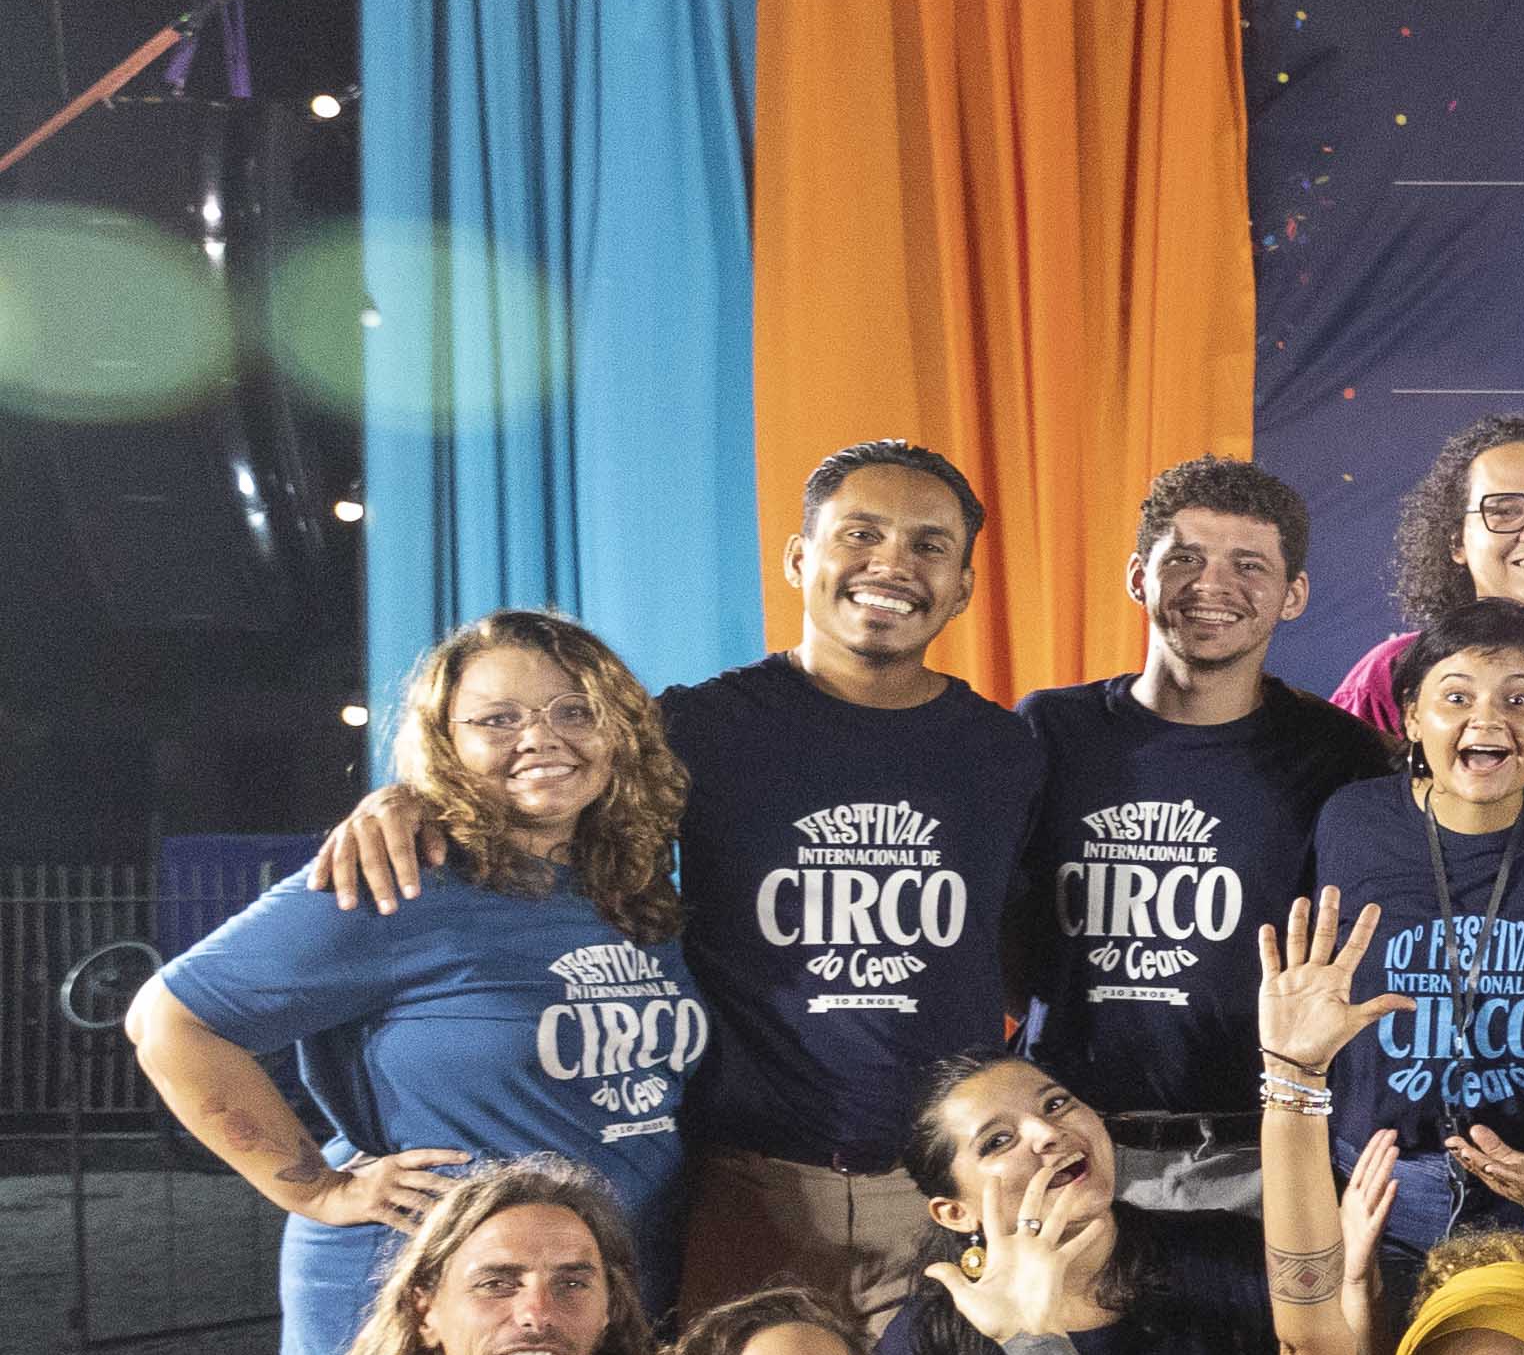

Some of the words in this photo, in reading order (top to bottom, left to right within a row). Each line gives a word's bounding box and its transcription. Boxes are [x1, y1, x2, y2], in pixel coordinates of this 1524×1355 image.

[793, 800, 941, 845] FESTIVAL
[1082, 799, 1221, 843] FESTIVAL
[798, 847, 918, 866] INTERNACIONAL
[922, 850, 940, 866] DE
[1084, 841, 1195, 862] INTERNACIONAL
[1198, 847, 1217, 862] DE
[756, 868, 967, 947] CIRCO
[1056, 861, 1242, 941] CIRCO
[548, 941, 664, 984] FESTIVAL
[806, 949, 844, 981] do
[850, 949, 926, 987] Ceará
[1088, 941, 1121, 972] do
[1126, 941, 1199, 980] Ceará
[537, 998, 708, 1080] CIRCO
[590, 1080, 620, 1112] do
[1388, 1061, 1432, 1101] do
